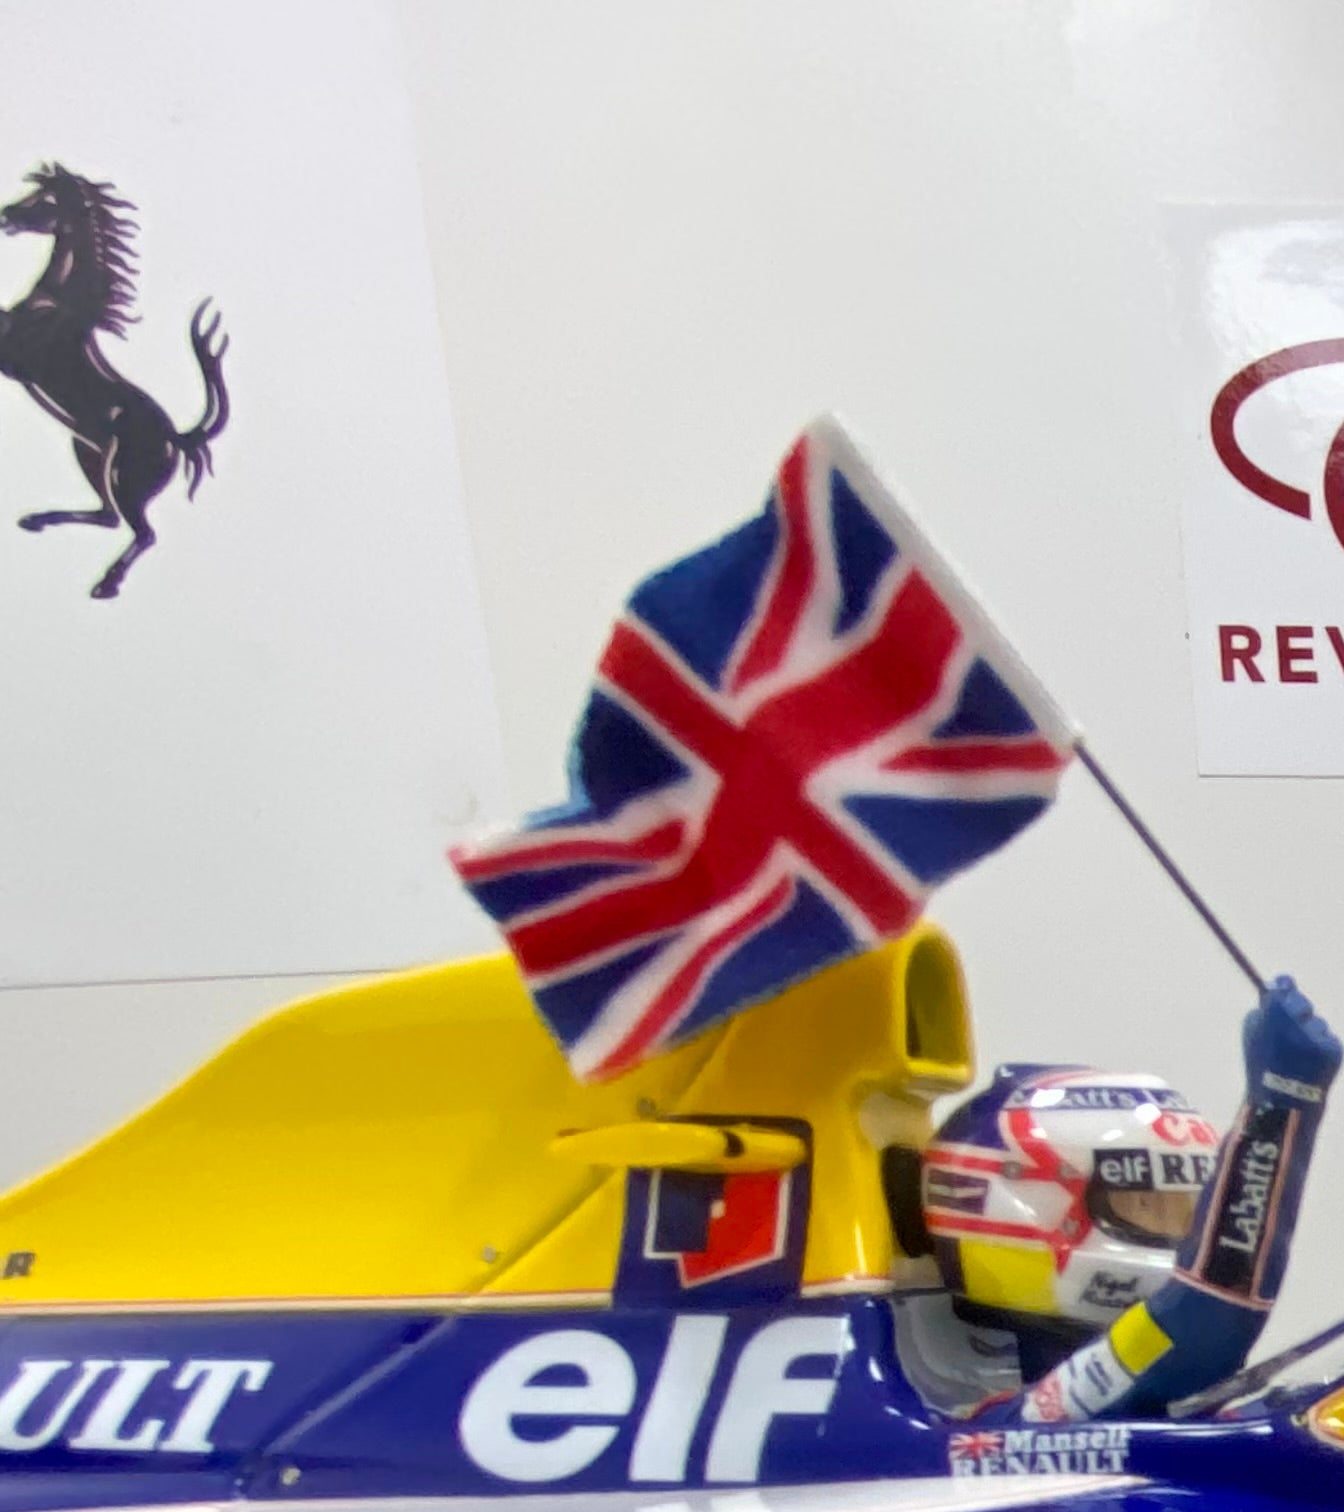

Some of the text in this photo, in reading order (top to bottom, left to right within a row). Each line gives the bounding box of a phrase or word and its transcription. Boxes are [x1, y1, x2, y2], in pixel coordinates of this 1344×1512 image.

[1101, 1155, 1149, 1187] elf
[1219, 1140, 1280, 1253] Labatt's
[458, 1315, 851, 1482] elf
[952, 1449, 1130, 1475] RENAULT
